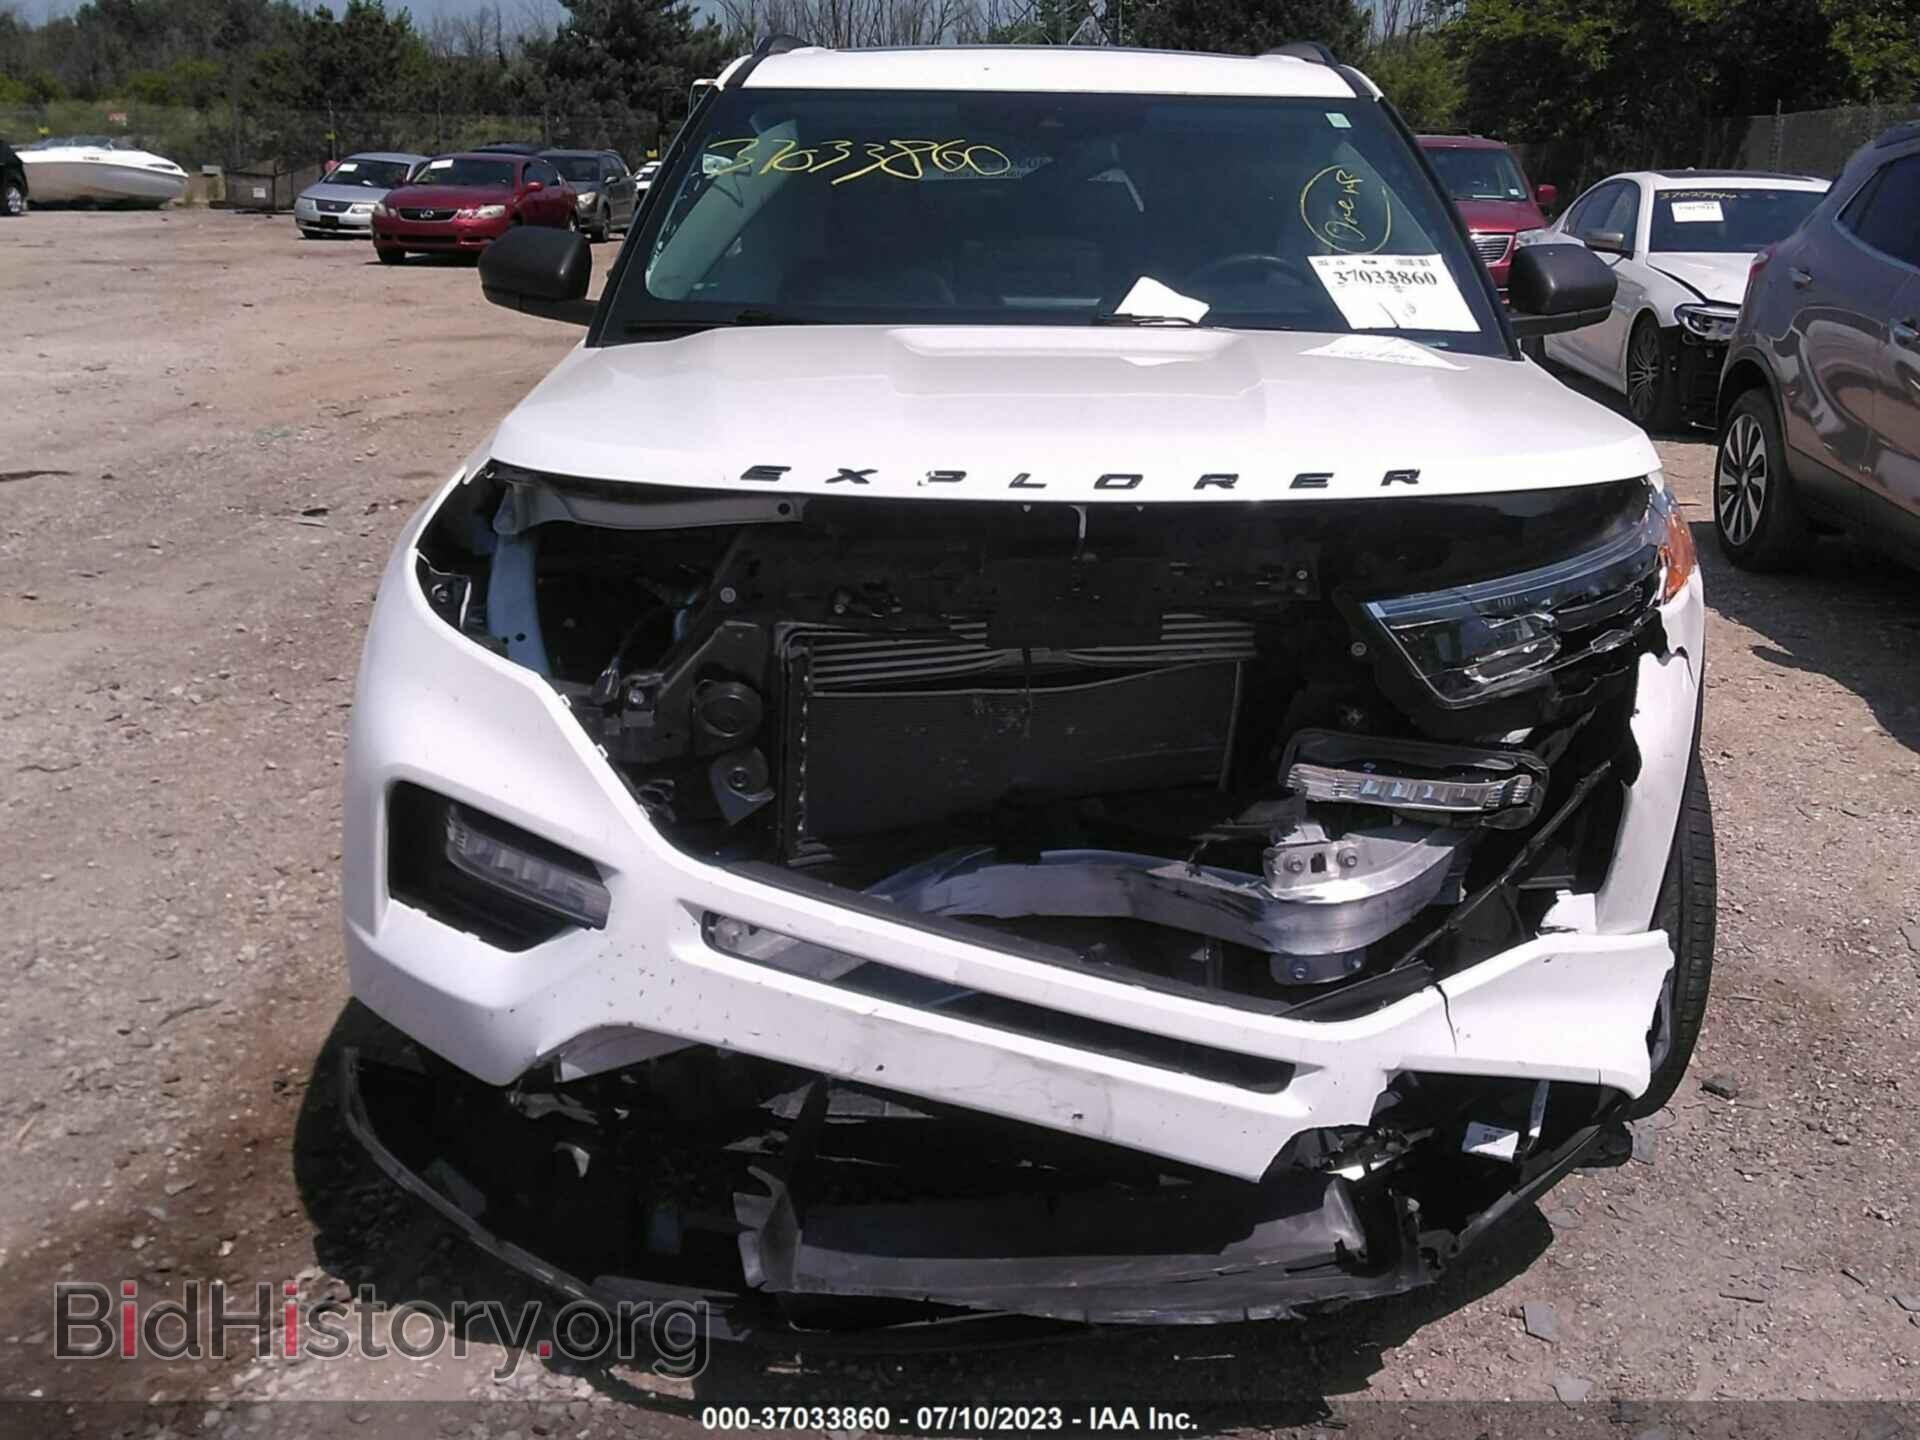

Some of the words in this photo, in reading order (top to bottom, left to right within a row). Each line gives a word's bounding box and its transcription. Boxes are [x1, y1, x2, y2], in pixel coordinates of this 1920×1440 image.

[708, 138, 1012, 185] 37033860
[1333, 269, 1438, 285] 37033860
[740, 465, 1421, 490] EXPLORER
